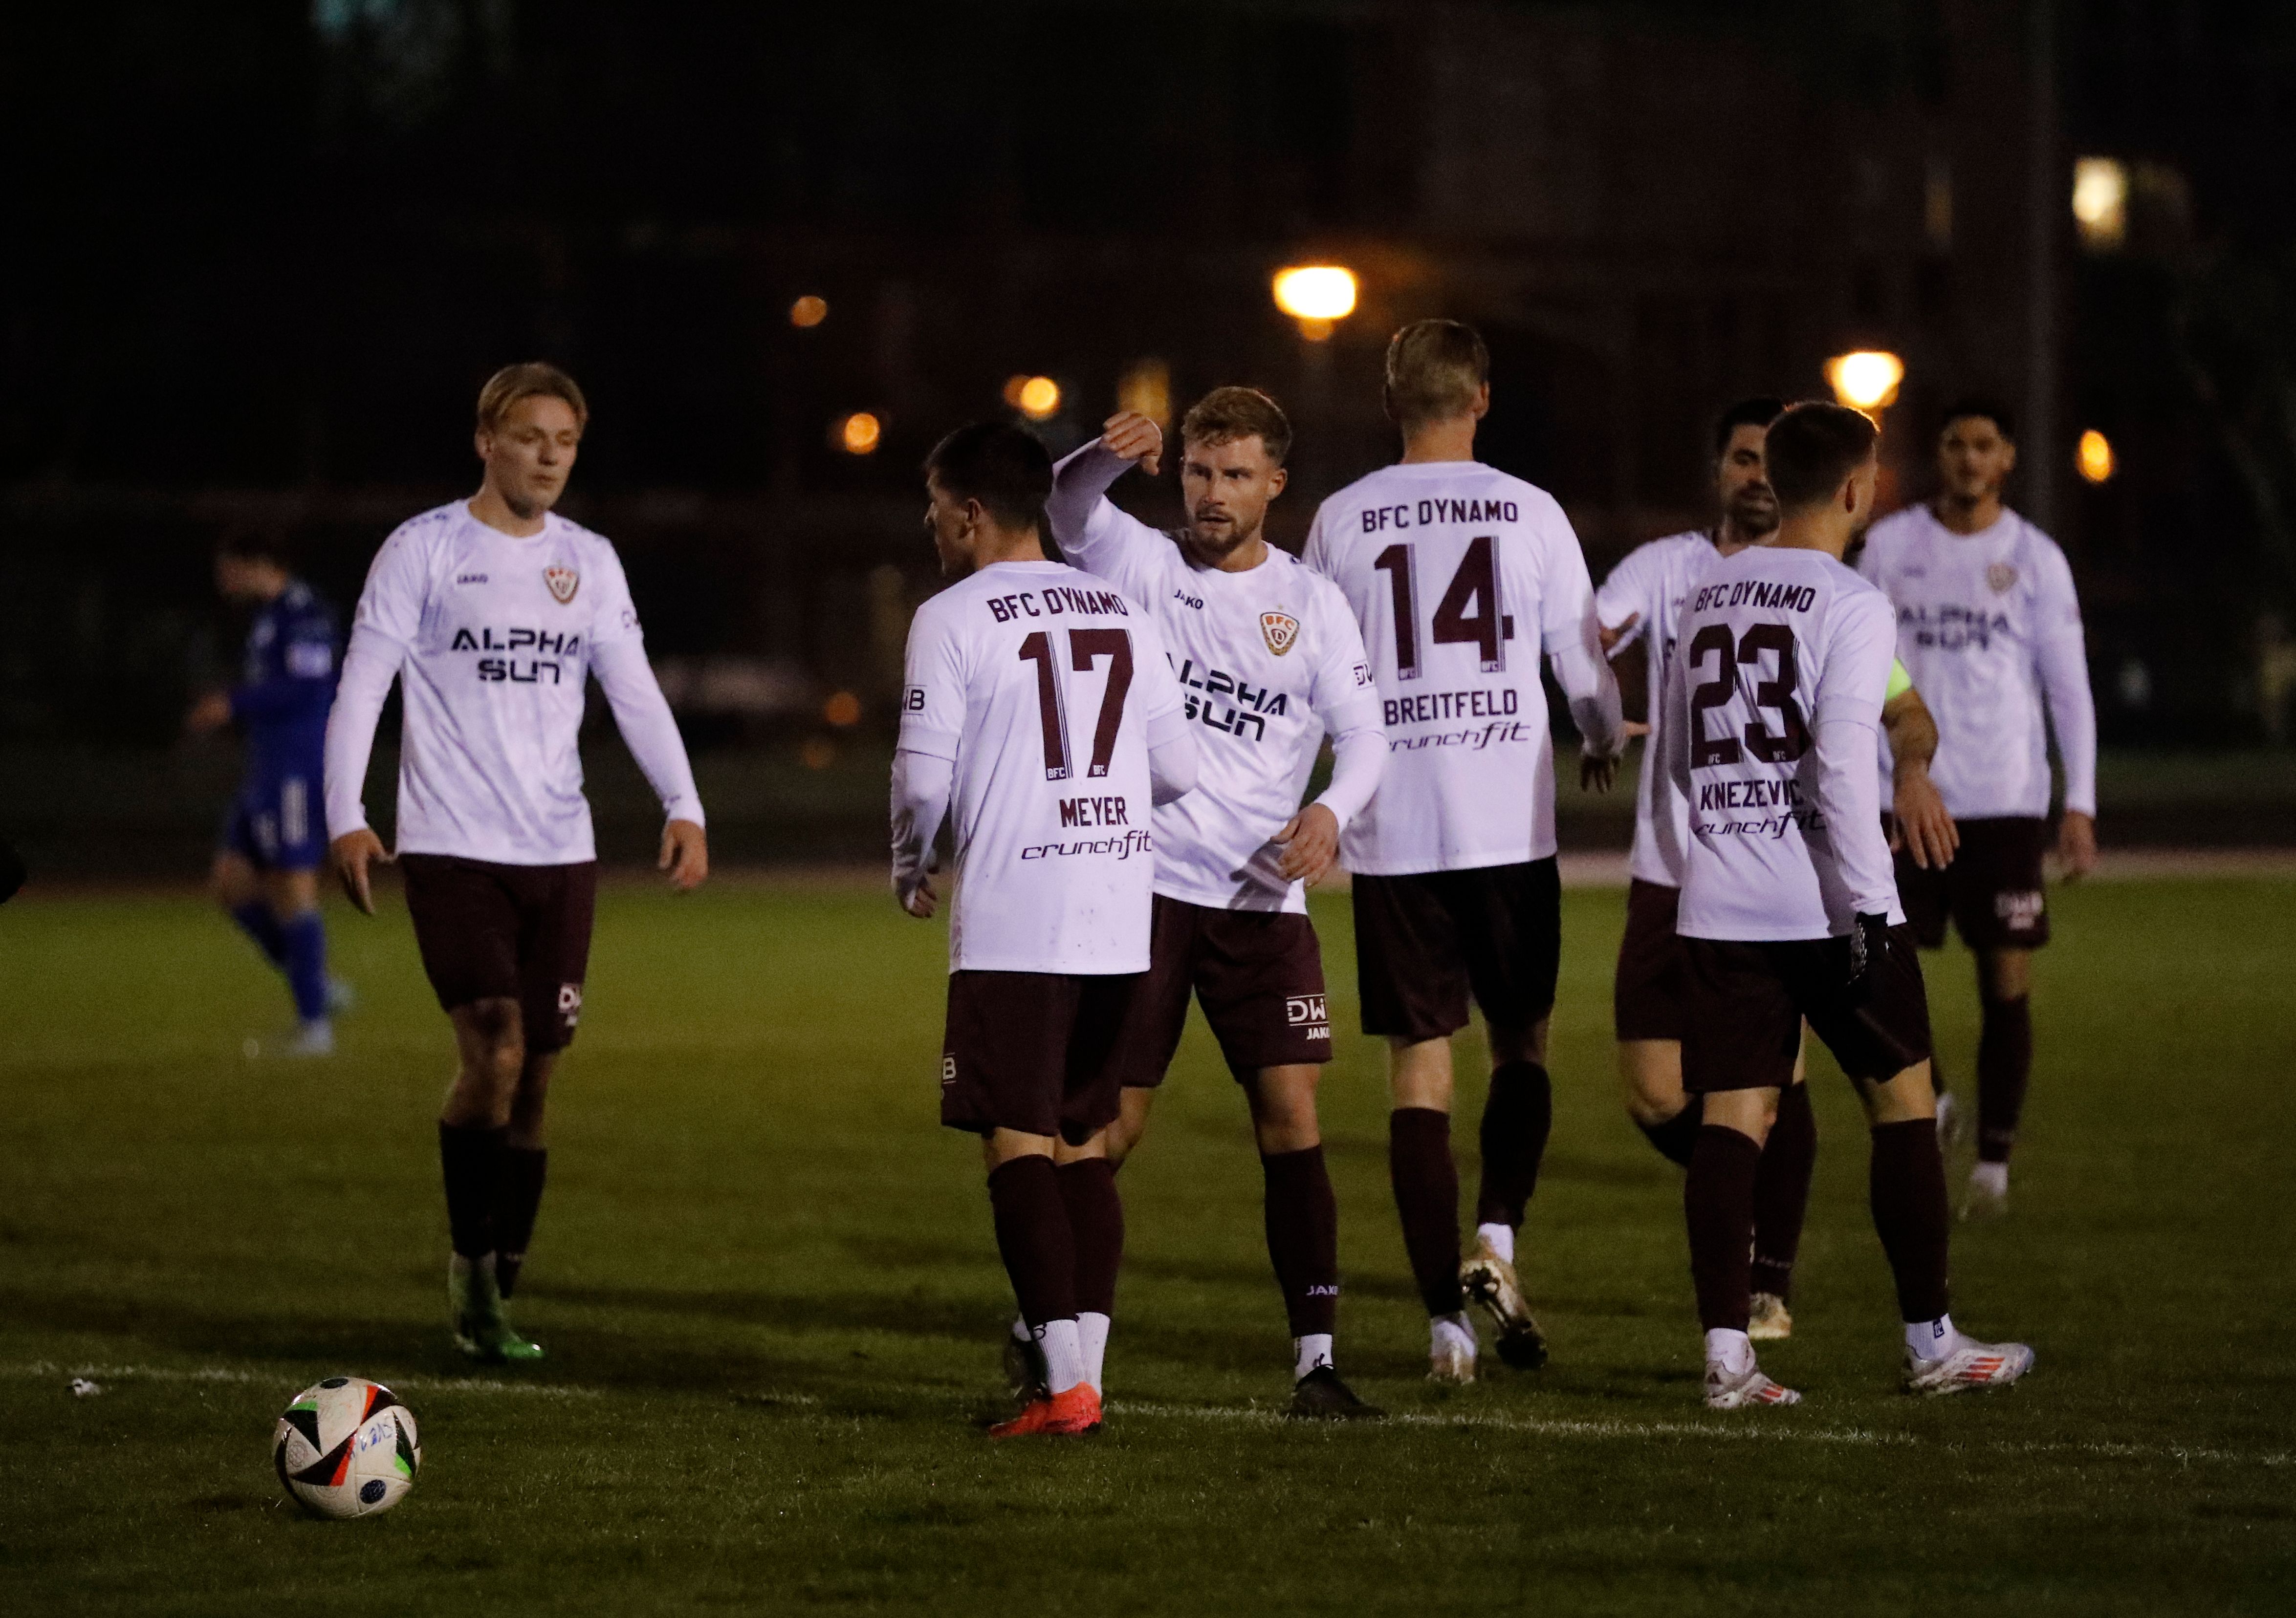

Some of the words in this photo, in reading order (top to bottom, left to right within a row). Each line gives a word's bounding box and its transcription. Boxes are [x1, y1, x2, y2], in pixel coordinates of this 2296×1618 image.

[1362, 505, 1409, 533] BFC
[1418, 499, 1518, 525] DYNAMO
[986, 592, 1040, 623] BFC
[1042, 587, 1129, 617] DYNAMO
[1374, 536, 1515, 681] 14
[1694, 584, 1729, 612] BFC
[1729, 581, 1816, 613] DYNAMO
[1266, 616, 1295, 631] BFC
[451, 628, 580, 656] ALPHA
[1166, 652, 1288, 716] LPHA
[1689, 623, 1808, 769] 23
[1018, 629, 1134, 780] 17
[1383, 689, 1518, 726] BREITFELD
[1389, 722, 1531, 752] runchfit
[1047, 768, 1065, 778] BFC
[1093, 765, 1105, 775] BFC
[1700, 778, 1805, 810] KNEZEVIC
[1059, 796, 1129, 827] MEYER
[1695, 809, 1827, 840] runchfit
[1021, 830, 1152, 860] crunchfit
